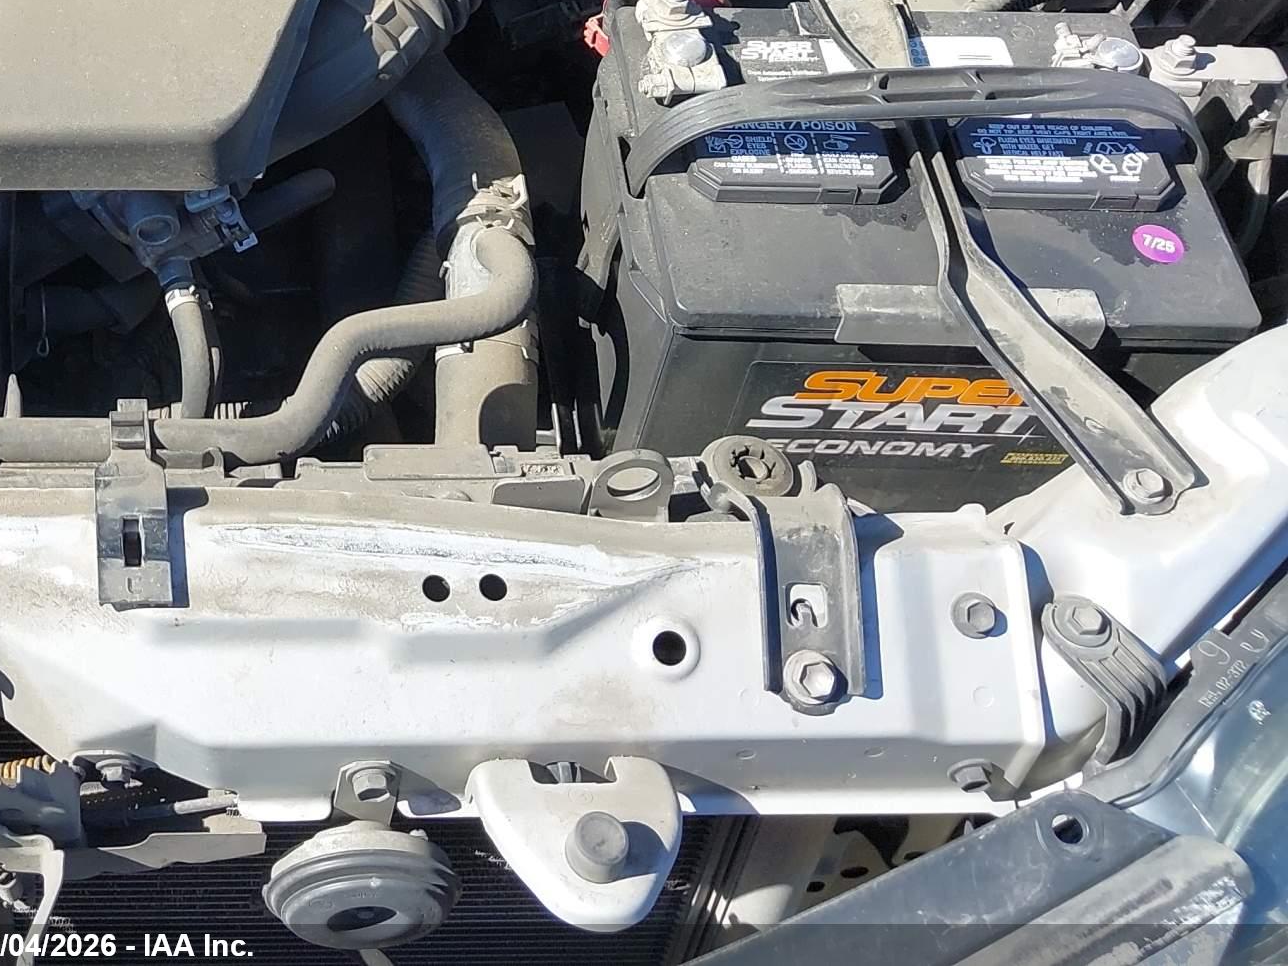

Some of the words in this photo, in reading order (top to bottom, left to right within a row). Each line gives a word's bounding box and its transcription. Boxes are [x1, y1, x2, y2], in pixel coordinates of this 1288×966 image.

[746, 39, 812, 51] SUPER
[741, 48, 815, 60] START
[801, 121, 857, 132] POISON
[794, 370, 1023, 406] SUPE
[745, 395, 1040, 434] START
